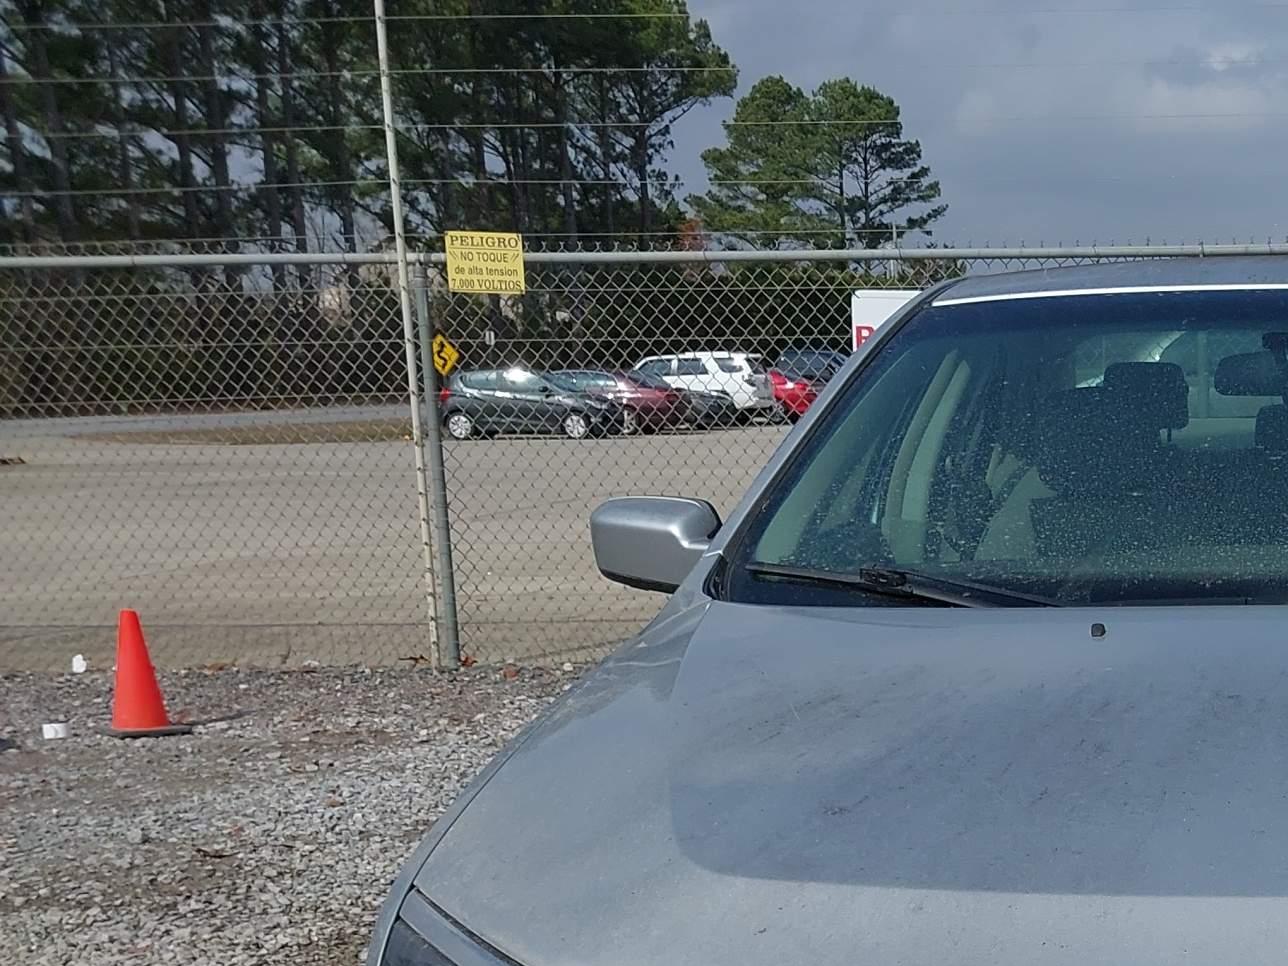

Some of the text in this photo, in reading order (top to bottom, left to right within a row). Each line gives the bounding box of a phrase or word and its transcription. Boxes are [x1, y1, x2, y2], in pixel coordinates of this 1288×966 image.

[450, 235, 518, 248] PELIGRO
[460, 252, 508, 263] NO TOQUE
[455, 264, 518, 277] de alta tension
[477, 279, 522, 290] VOLTIOS
